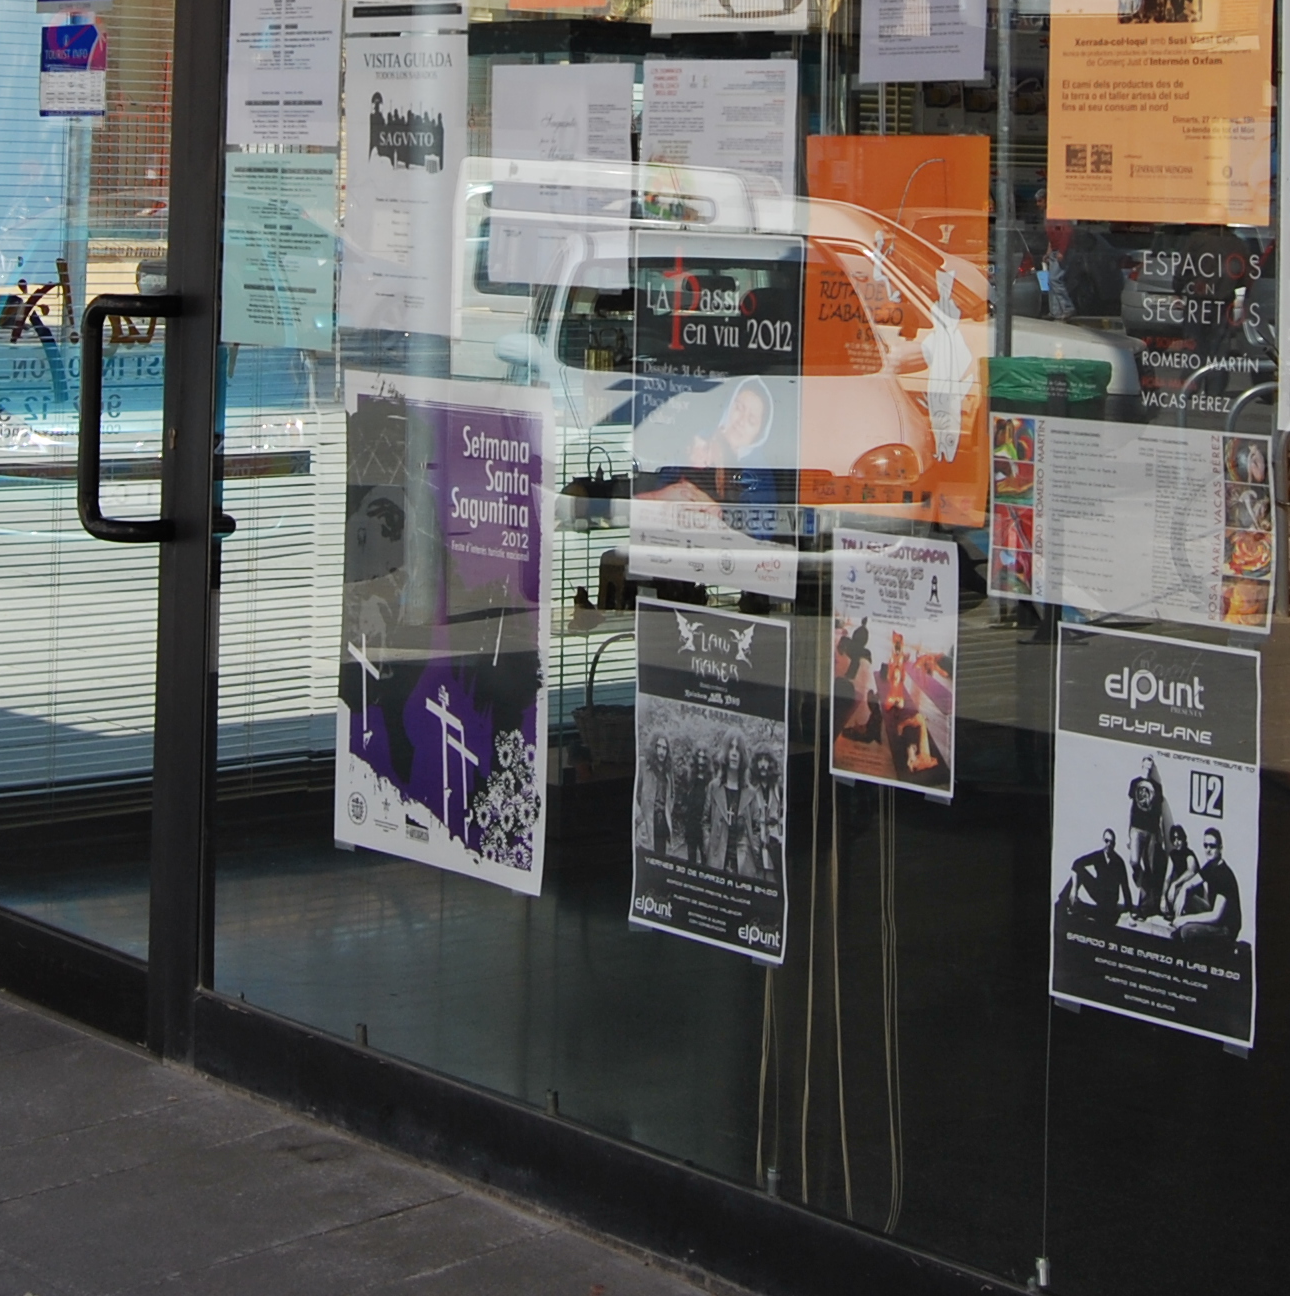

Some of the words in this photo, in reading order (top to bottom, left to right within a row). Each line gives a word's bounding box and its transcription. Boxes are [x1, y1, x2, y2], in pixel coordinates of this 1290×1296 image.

[1168, 36, 1187, 45] Susi
[45, 50, 71, 60] TOURIST
[72, 49, 88, 59] INFO
[364, 54, 401, 68] VISITA
[405, 52, 453, 68] GUIADA
[1193, 57, 1222, 65] Oxfam
[1062, 80, 1070, 89] El
[1094, 79, 1110, 89] dels
[1113, 79, 1153, 91] productes
[1156, 79, 1171, 89] des
[1174, 79, 1184, 89] de
[1062, 91, 1069, 100] la
[1071, 92, 1090, 100] terra
[1099, 91, 1106, 100] el
[1109, 91, 1130, 100] taller
[1159, 91, 1172, 100] del
[1174, 91, 1189, 100] sud
[1062, 103, 1076, 111] fins
[1078, 103, 1086, 111] al
[1140, 103, 1147, 111] al
[1149, 103, 1169, 111] nord
[379, 131, 434, 148] SAGVNTO
[1143, 251, 1262, 280] ESPACIOS
[819, 280, 861, 300] RUTA
[865, 283, 885, 302] DE
[1186, 281, 1215, 295] CON
[1142, 297, 1261, 327] SECRETOS
[683, 321, 707, 347] en
[713, 317, 739, 348] viu
[747, 318, 793, 352] 2012
[1142, 351, 1201, 369] ROMERO
[1206, 353, 1259, 373] MARTÍN
[1141, 391, 1186, 409] VACAS
[1192, 391, 1231, 413] PÉREZ
[462, 425, 530, 464] Setmana
[485, 460, 530, 496] Santa
[1036, 468, 1045, 519] ROMERO
[1213, 480, 1223, 526] VACAS
[451, 486, 529, 529] Saguntina
[501, 531, 529, 549] 2012
[1209, 583, 1218, 621] ROSA
[1098, 713, 1213, 745] SPLYPLANE
[1212, 759, 1243, 772] TRIBUTE
[1244, 765, 1256, 773] TO
[1191, 772, 1223, 817] U2
[1120, 945, 1134, 956] DE
[1137, 949, 1173, 965] MARZO
[1176, 959, 1184, 967] A
[1187, 960, 1207, 973] LAS
